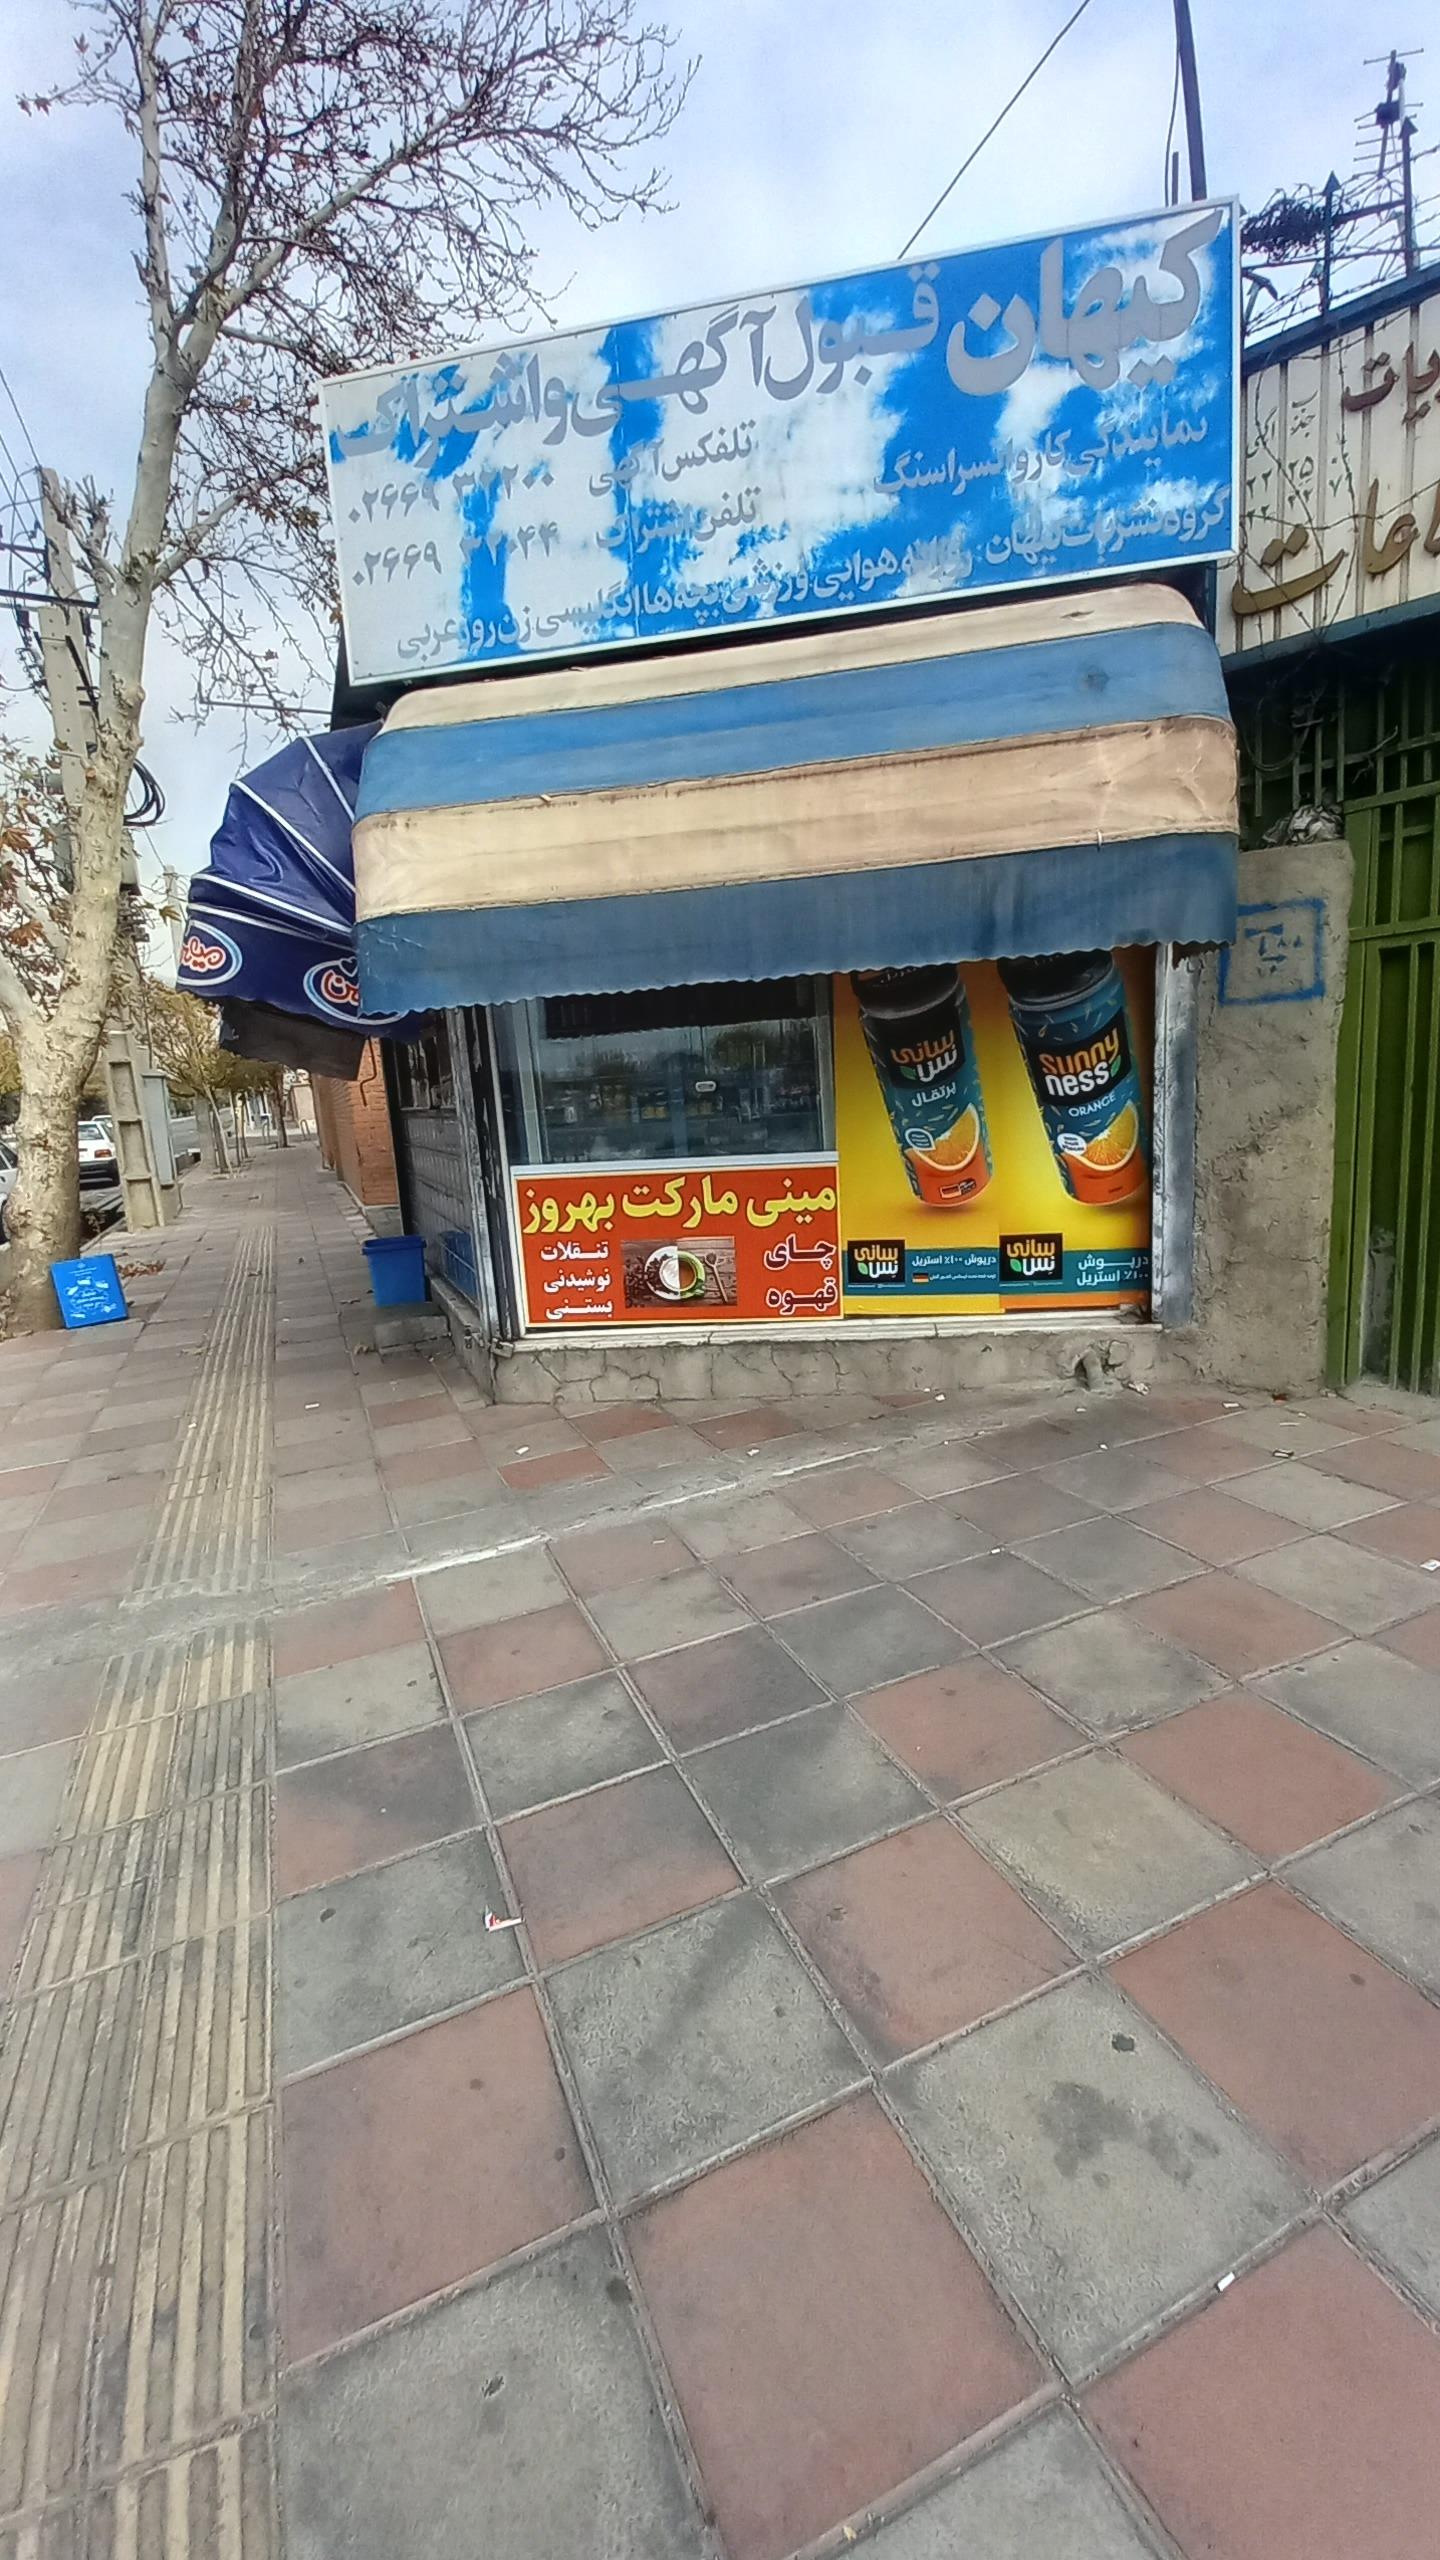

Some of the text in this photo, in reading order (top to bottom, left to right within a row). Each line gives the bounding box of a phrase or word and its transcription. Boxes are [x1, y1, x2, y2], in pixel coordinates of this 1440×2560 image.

[946, 209, 1224, 396] کیهان
[765, 262, 941, 402] قبول
[571, 303, 777, 437] آگهی
[588, 438, 665, 497] آگهی
[661, 419, 756, 482] تلفکس
[693, 486, 762, 541] تلفن
[1163, 483, 1232, 542] گروه
[397, 618, 460, 662] عربی
[1067, 1092, 1116, 1118] ORANGE
[522, 1173, 837, 1235] مینی مارکت بهروز
[540, 1240, 609, 1261] تنقلات
[763, 1232, 837, 1271] چای
[853, 1244, 899, 1262] سانی
[1006, 1238, 1056, 1258] سانی
[543, 1268, 611, 1293] نوشیدنی
[765, 1277, 838, 1316] قهوه
[545, 1298, 613, 1320] بستنی
